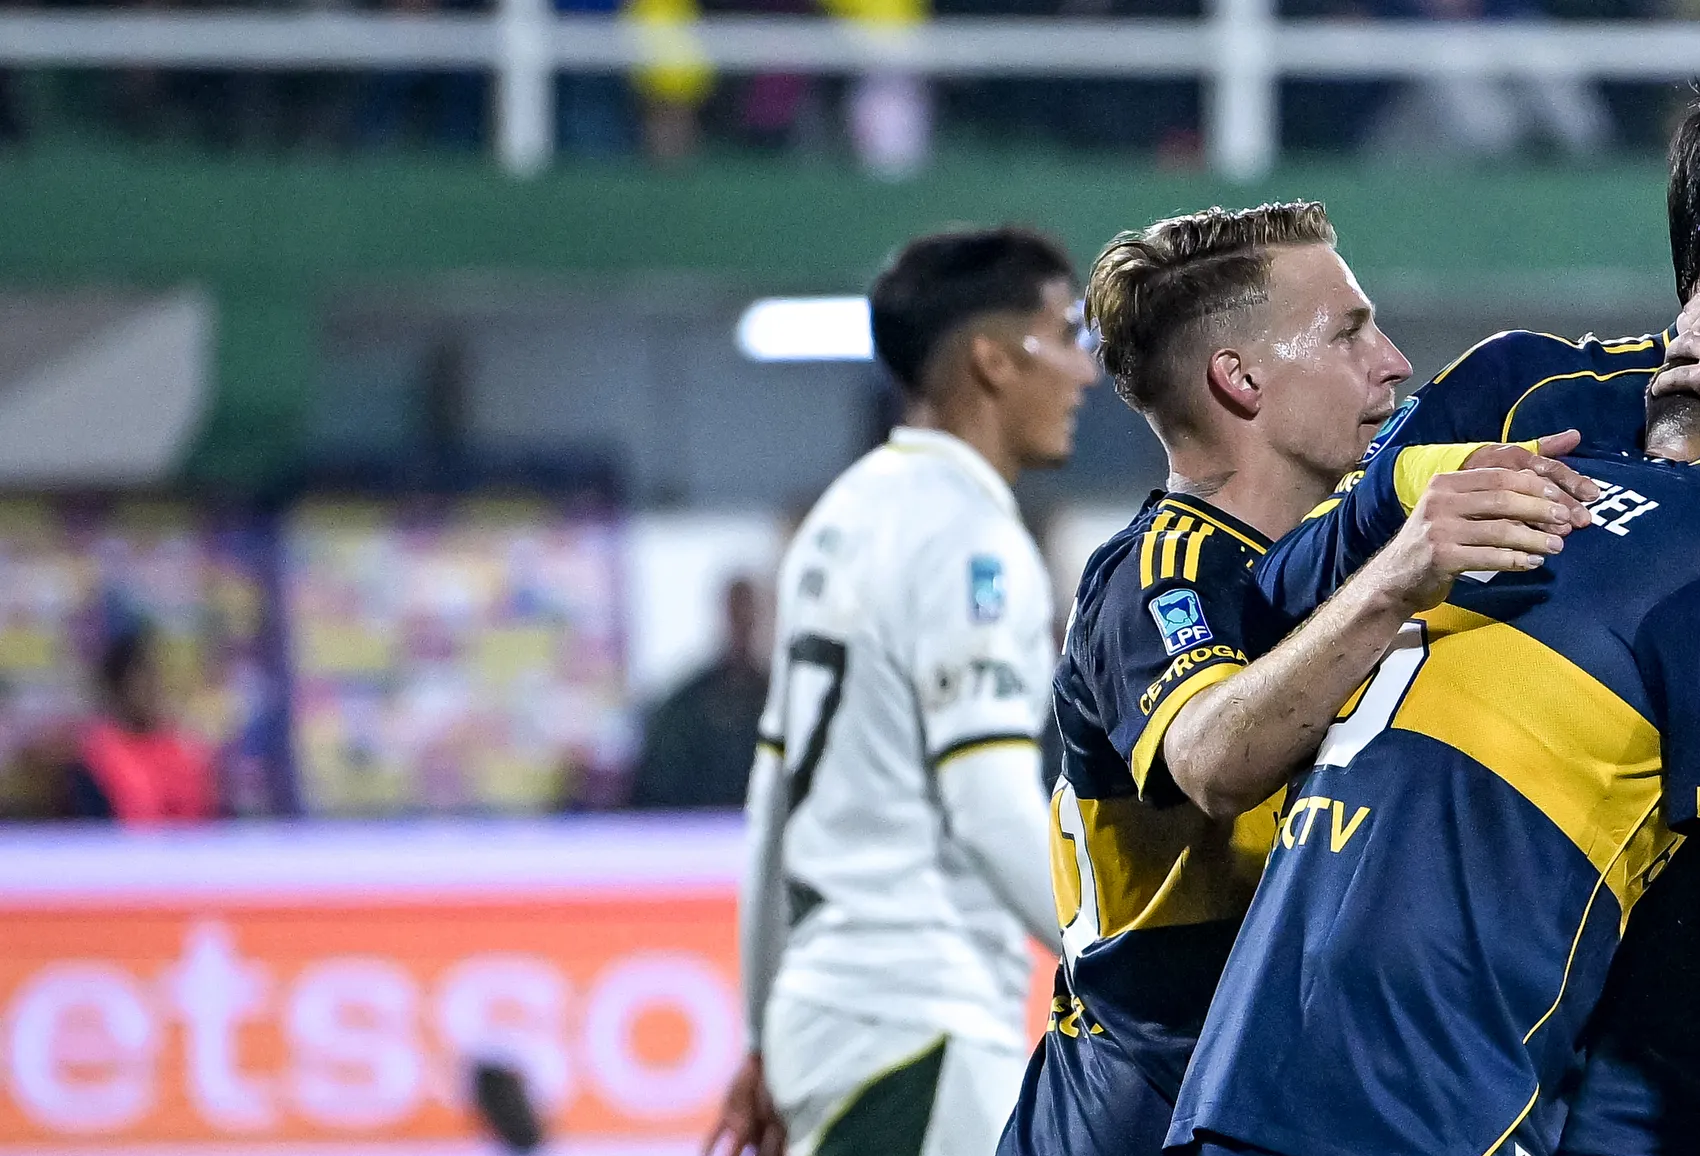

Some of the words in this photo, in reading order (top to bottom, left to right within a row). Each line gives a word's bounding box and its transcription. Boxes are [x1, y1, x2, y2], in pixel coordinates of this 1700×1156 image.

[1166, 625, 1208, 652] LPF
[1139, 645, 1250, 716] CETROGA
[8, 912, 745, 1134] etsso
